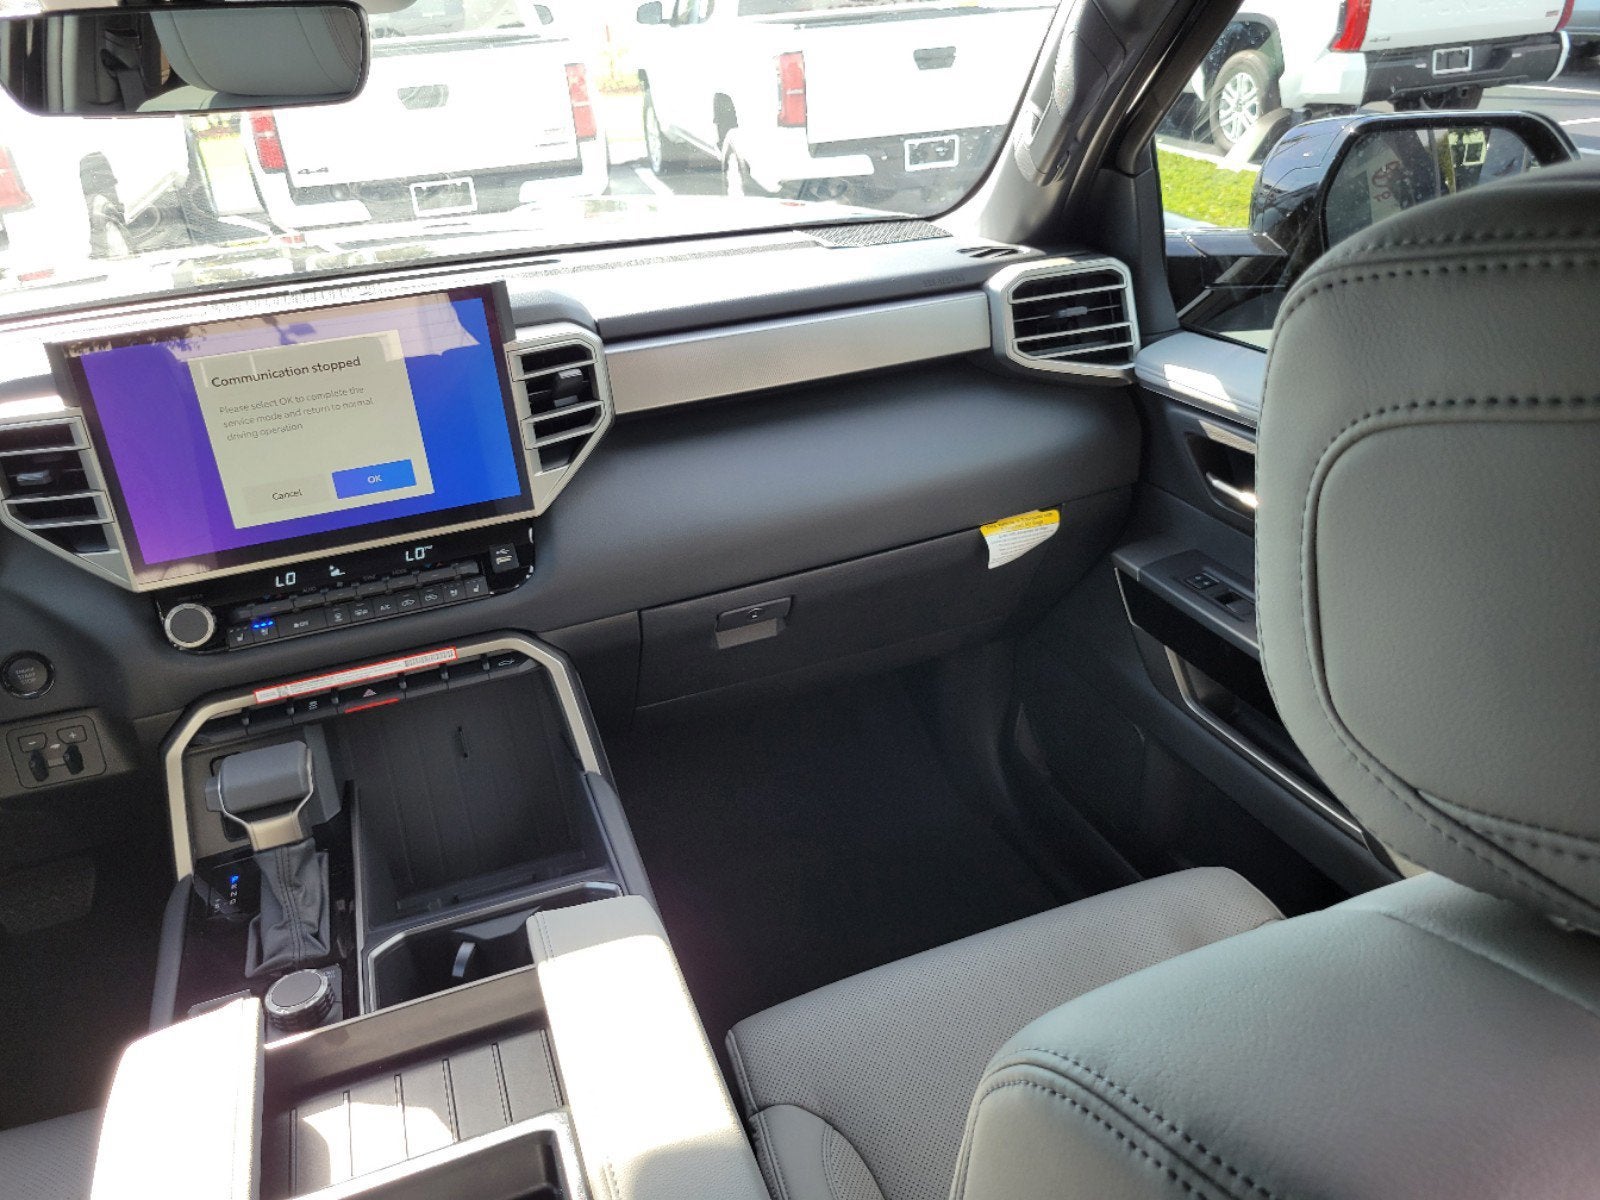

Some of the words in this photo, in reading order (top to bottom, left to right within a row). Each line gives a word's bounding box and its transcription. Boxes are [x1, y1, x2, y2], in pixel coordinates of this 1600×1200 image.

[211, 365, 310, 388] Communication
[312, 356, 361, 373] stopped
[219, 404, 250, 414] Please
[251, 400, 278, 410] select
[279, 397, 294, 405] OK
[295, 395, 306, 404] to
[306, 388, 348, 402] complete
[349, 385, 365, 395] the
[223, 418, 255, 429] service
[256, 411, 283, 424] mode
[284, 408, 302, 420] and
[303, 404, 330, 416] return
[331, 402, 341, 411] to
[342, 396, 374, 409] normal
[227, 429, 259, 442] driving
[260, 421, 304, 437] operation
[367, 474, 382, 484] OK
[272, 489, 303, 500] Cancel
[405, 546, 425, 562] LO
[275, 571, 297, 588] LO
